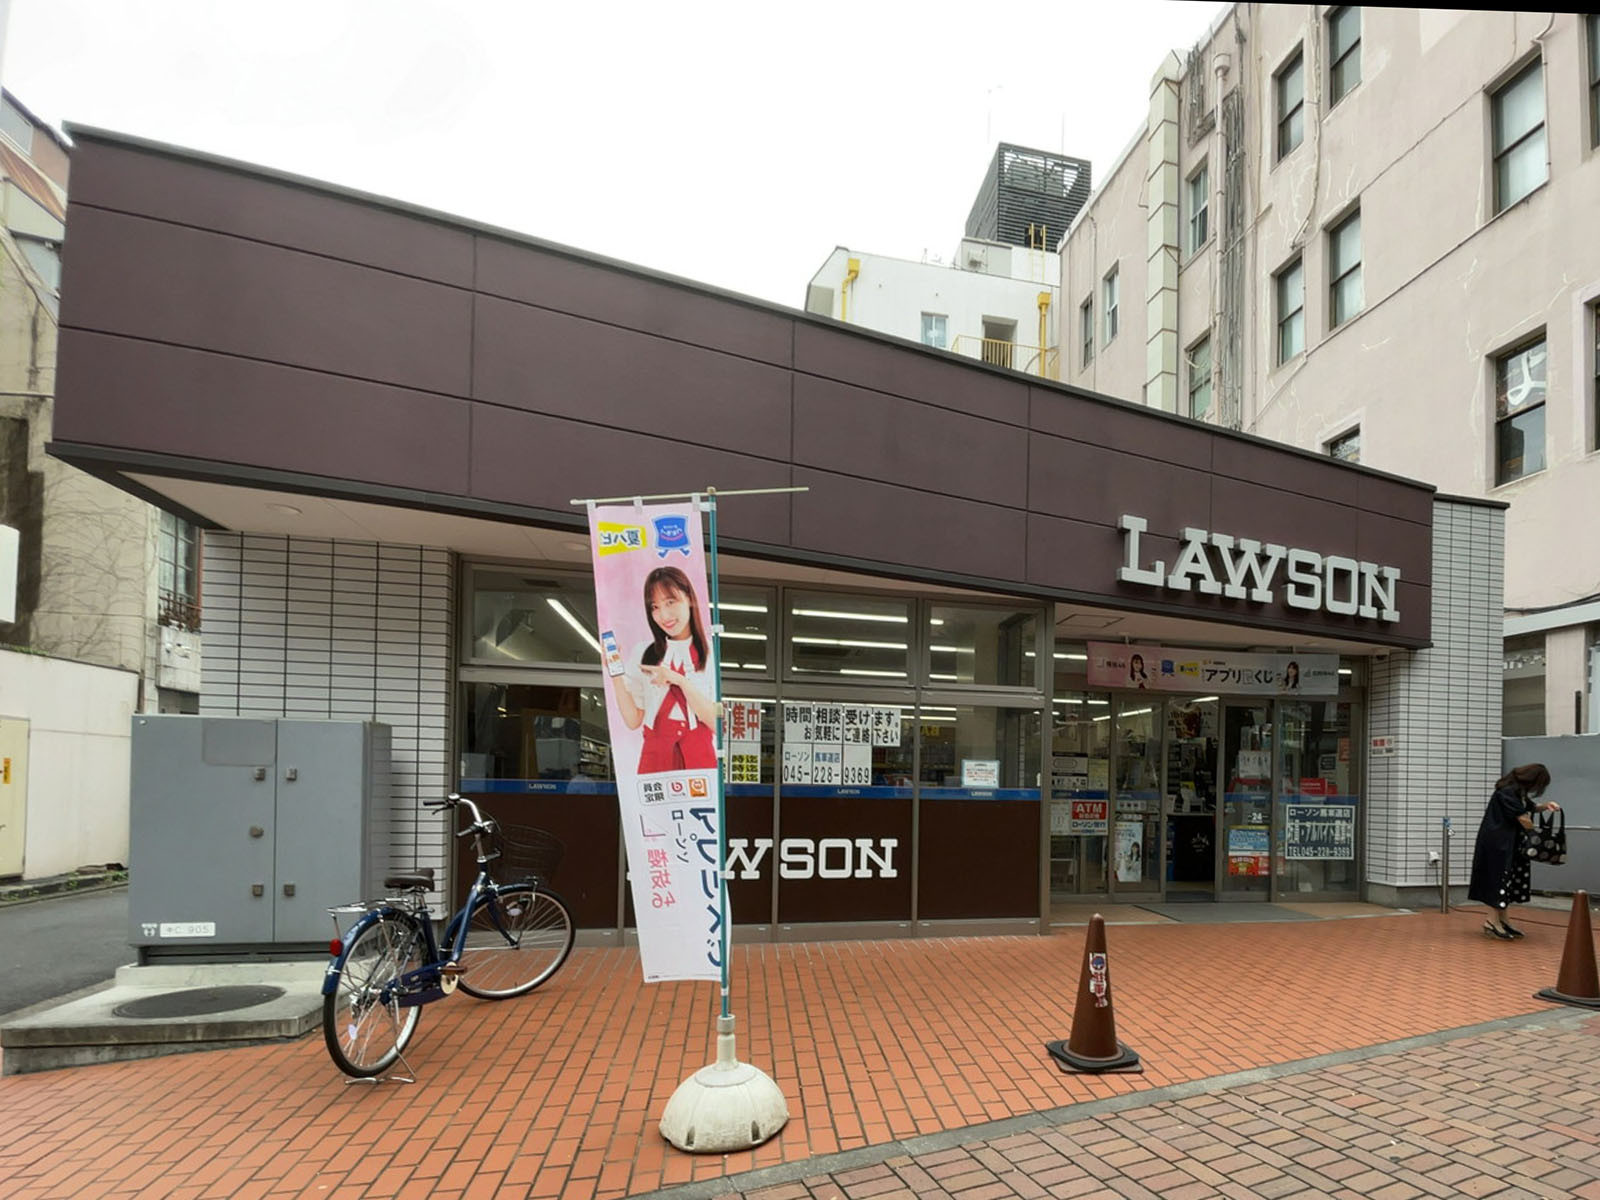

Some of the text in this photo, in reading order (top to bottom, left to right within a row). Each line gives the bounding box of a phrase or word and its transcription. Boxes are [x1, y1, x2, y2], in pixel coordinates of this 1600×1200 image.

[1118, 514, 1400, 623] LAWSON
[784, 765, 870, 783] 045-228-9369
[1076, 803, 1103, 813] ATM
[720, 838, 898, 880] WSON
